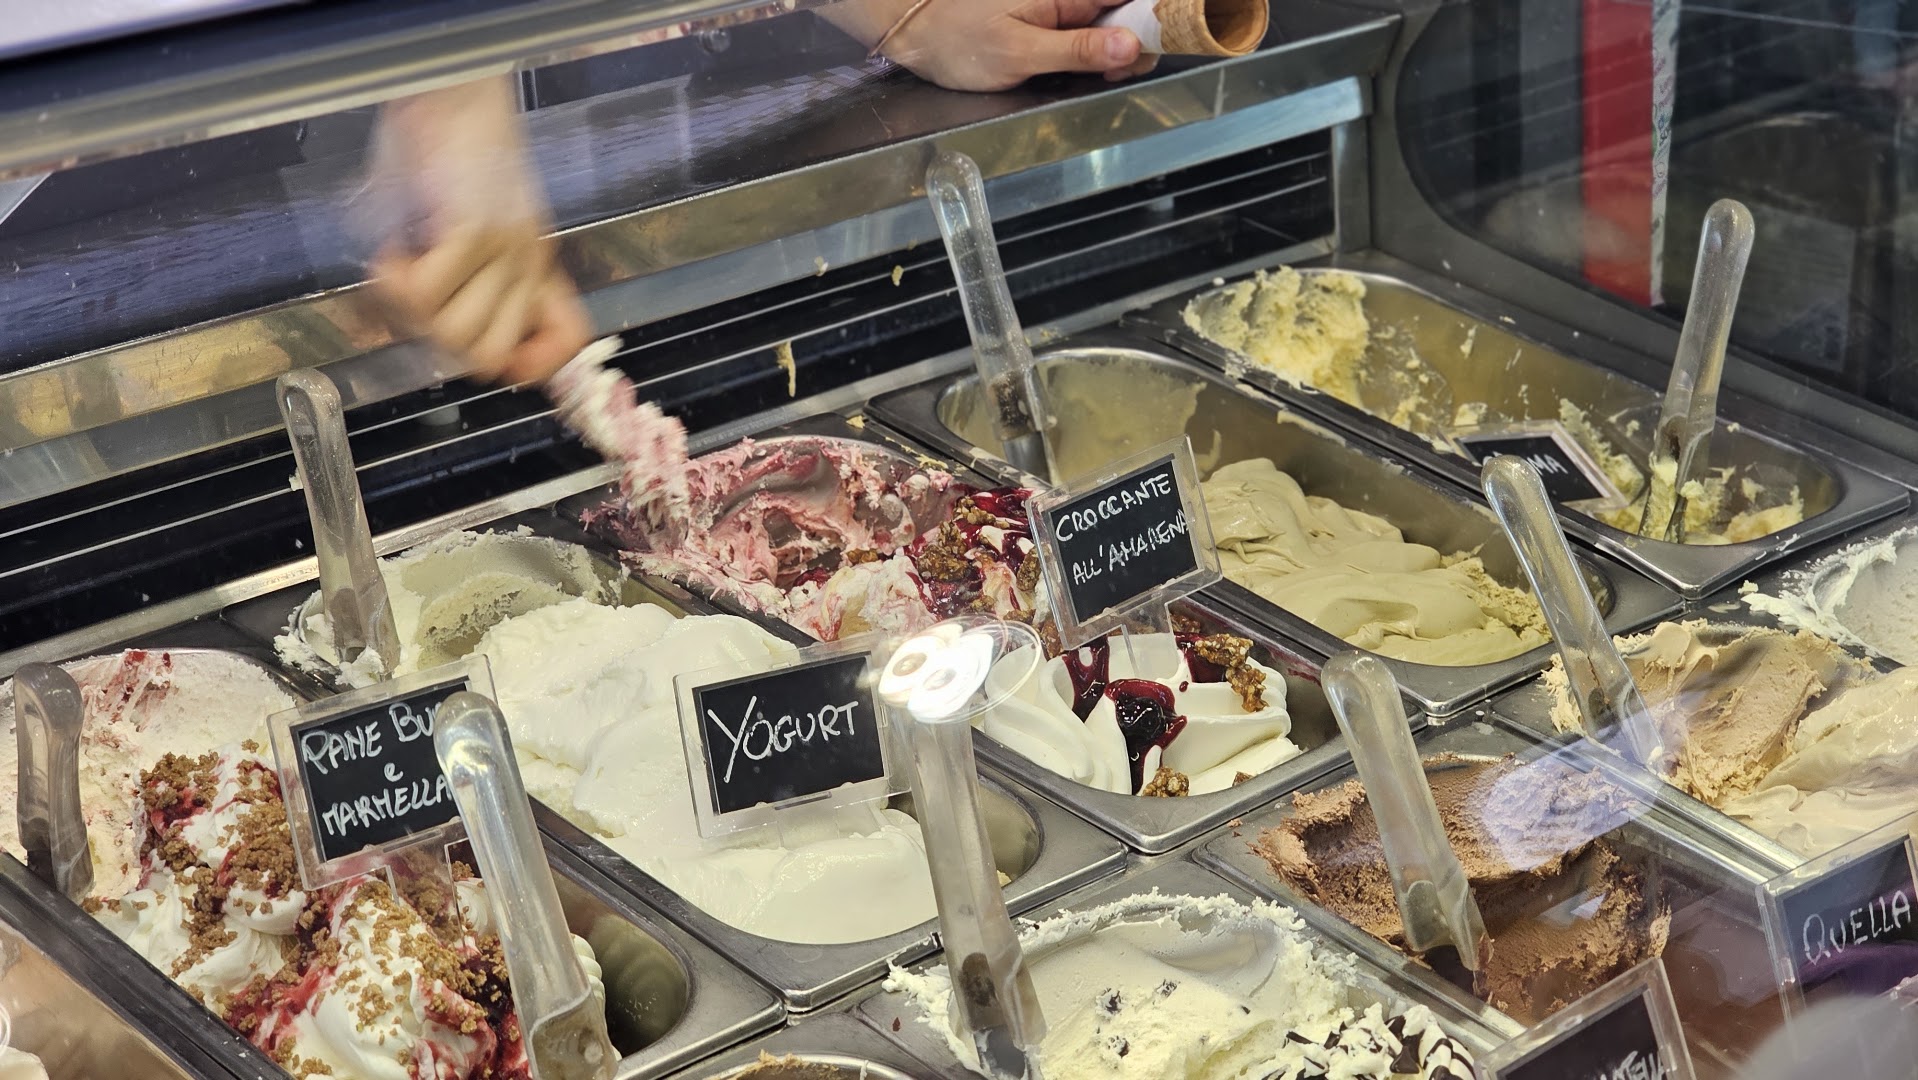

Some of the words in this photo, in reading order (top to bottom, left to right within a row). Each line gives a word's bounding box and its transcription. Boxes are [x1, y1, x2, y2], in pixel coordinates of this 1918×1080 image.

[1055, 473, 1172, 542] CROCCANTE
[301, 721, 383, 775] PANE
[388, 701, 442, 743] BU
[707, 695, 859, 784] YOGURT
[321, 774, 453, 837] MARMELLA
[1803, 890, 1911, 966] QUELLA
